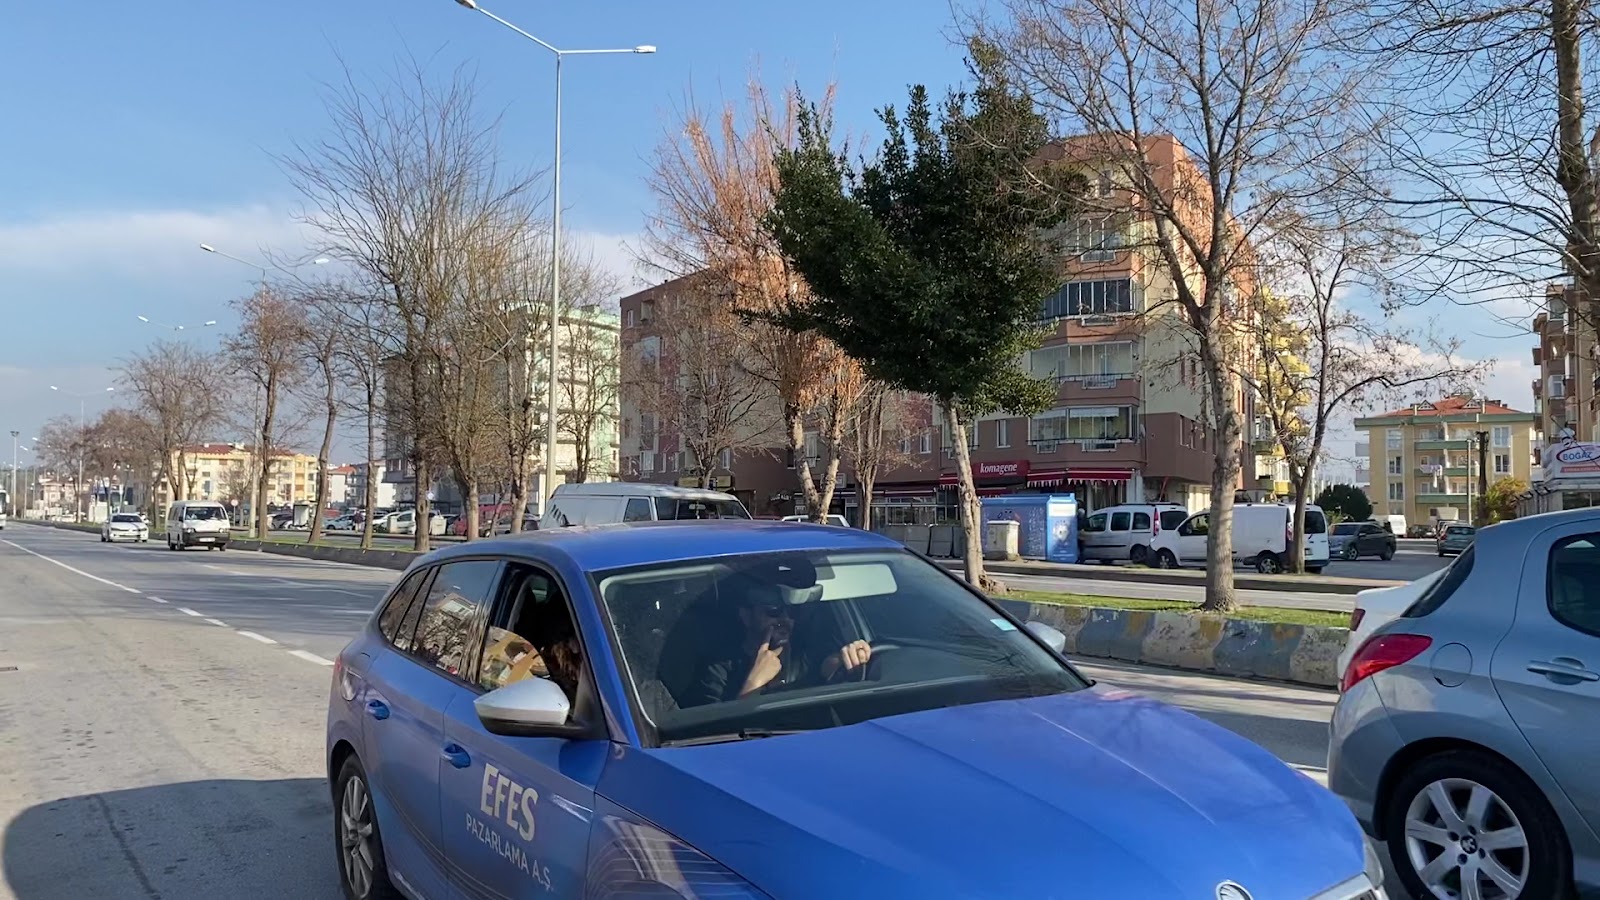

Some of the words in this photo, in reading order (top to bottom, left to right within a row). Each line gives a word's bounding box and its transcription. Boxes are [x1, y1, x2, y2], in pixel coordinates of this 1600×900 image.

[980, 462, 1018, 475] komagene
[480, 763, 538, 842] EFES
[465, 813, 530, 875] PAZARLAMA
